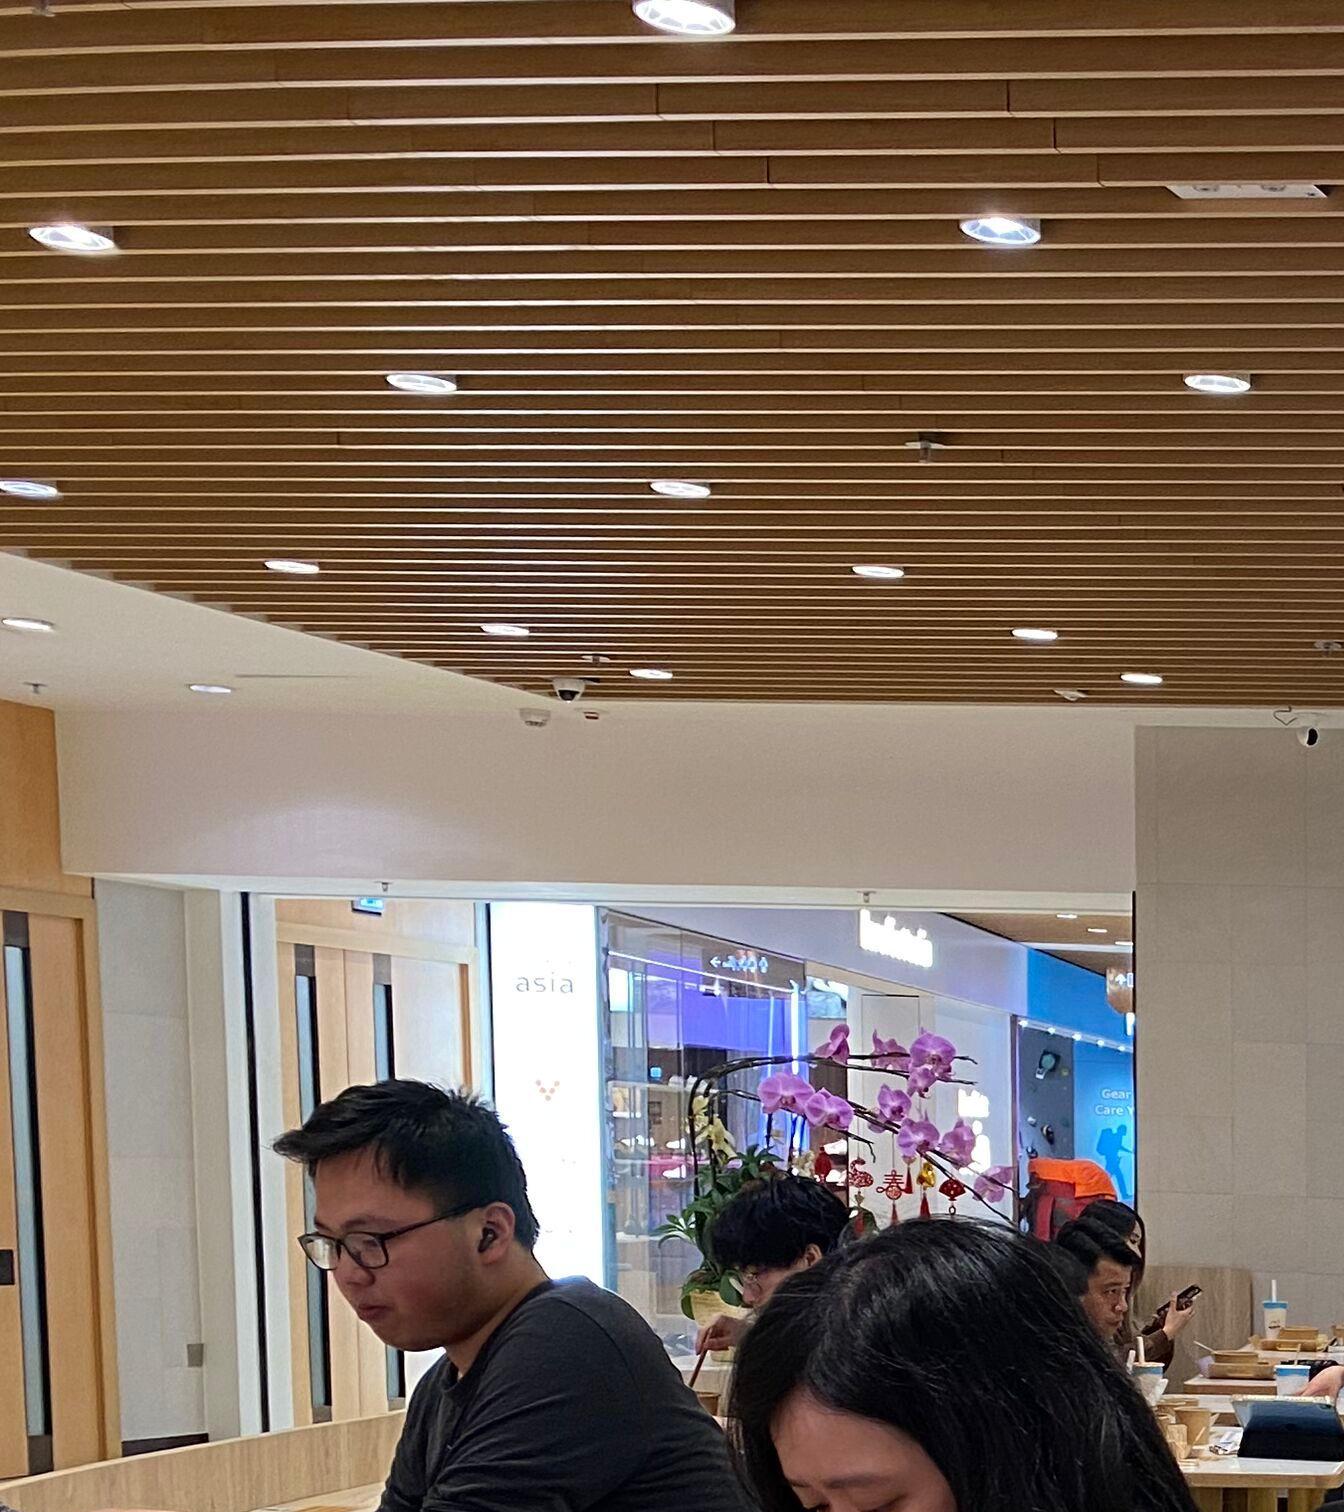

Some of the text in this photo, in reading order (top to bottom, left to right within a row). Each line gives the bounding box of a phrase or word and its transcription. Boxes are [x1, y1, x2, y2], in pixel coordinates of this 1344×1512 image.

[516, 971, 573, 994] asia
[1101, 1088, 1132, 1099] Gear
[1094, 1104, 1124, 1116] Care
